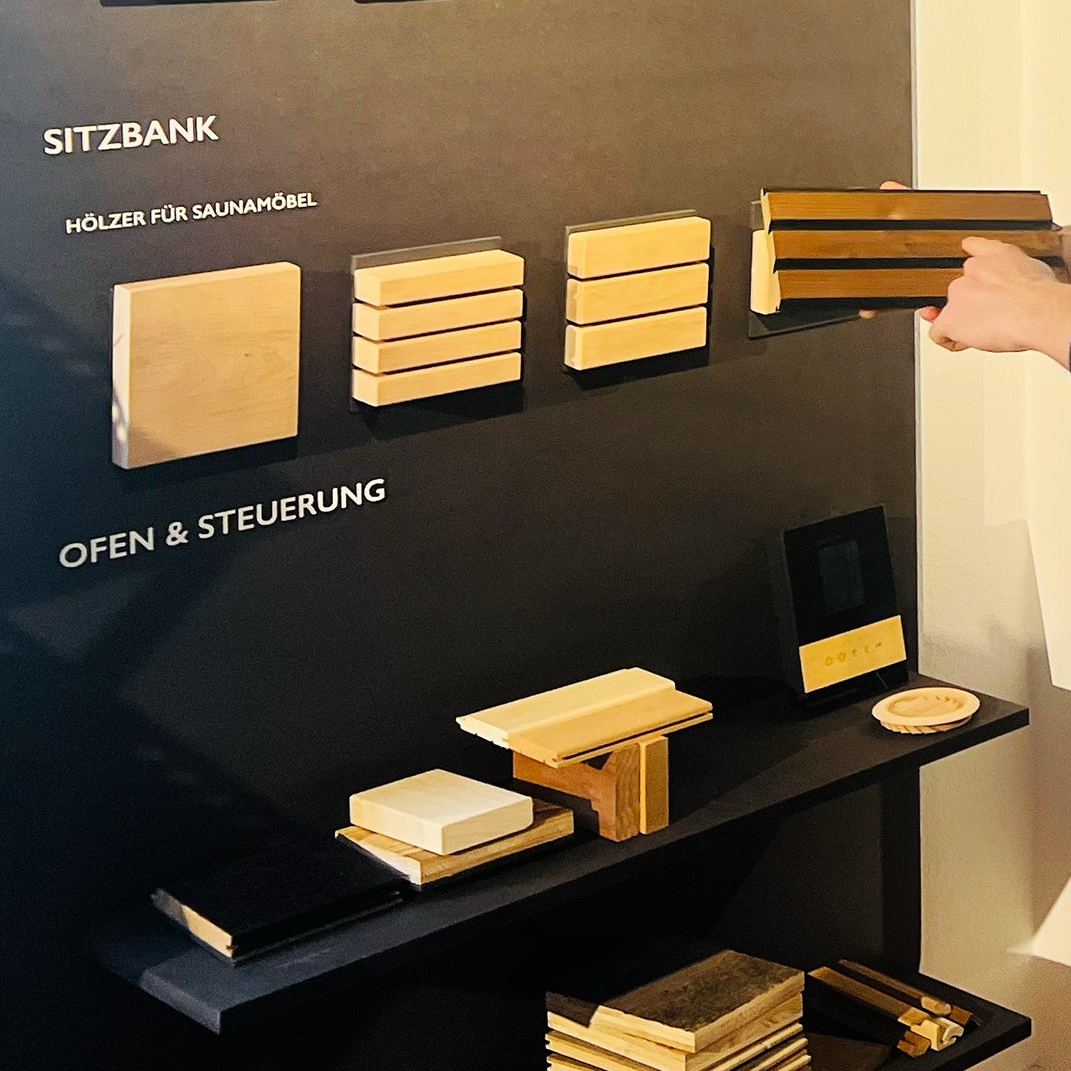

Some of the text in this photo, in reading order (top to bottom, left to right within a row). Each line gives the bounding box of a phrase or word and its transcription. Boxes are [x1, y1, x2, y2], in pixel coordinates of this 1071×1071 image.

[43, 115, 220, 155] SITZBANK
[65, 191, 319, 234] HÖLZER FÜR SAUNAMÖBEL
[59, 478, 387, 568] OFEN & STEUERUNG
